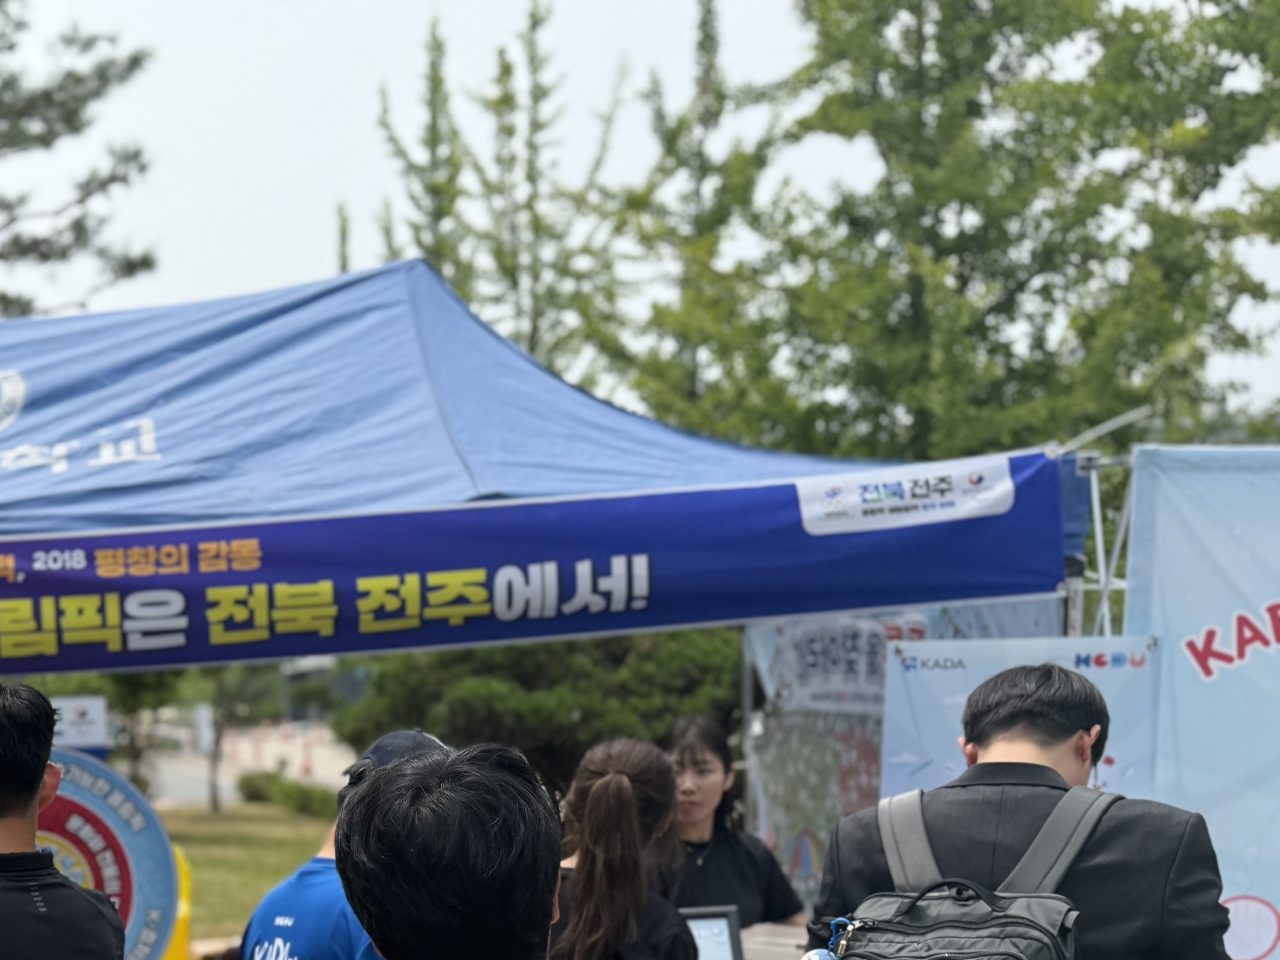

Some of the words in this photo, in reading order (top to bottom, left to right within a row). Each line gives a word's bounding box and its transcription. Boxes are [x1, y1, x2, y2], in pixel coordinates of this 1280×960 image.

[858, 481, 906, 504] 전북
[908, 474, 954, 500] 전주
[32, 548, 87, 572] 2018
[93, 541, 191, 578] 평창의
[197, 538, 263, 574] 감동
[205, 579, 339, 646] 전북
[355, 552, 652, 635] 전주에서!
[920, 658, 966, 671] KADA
